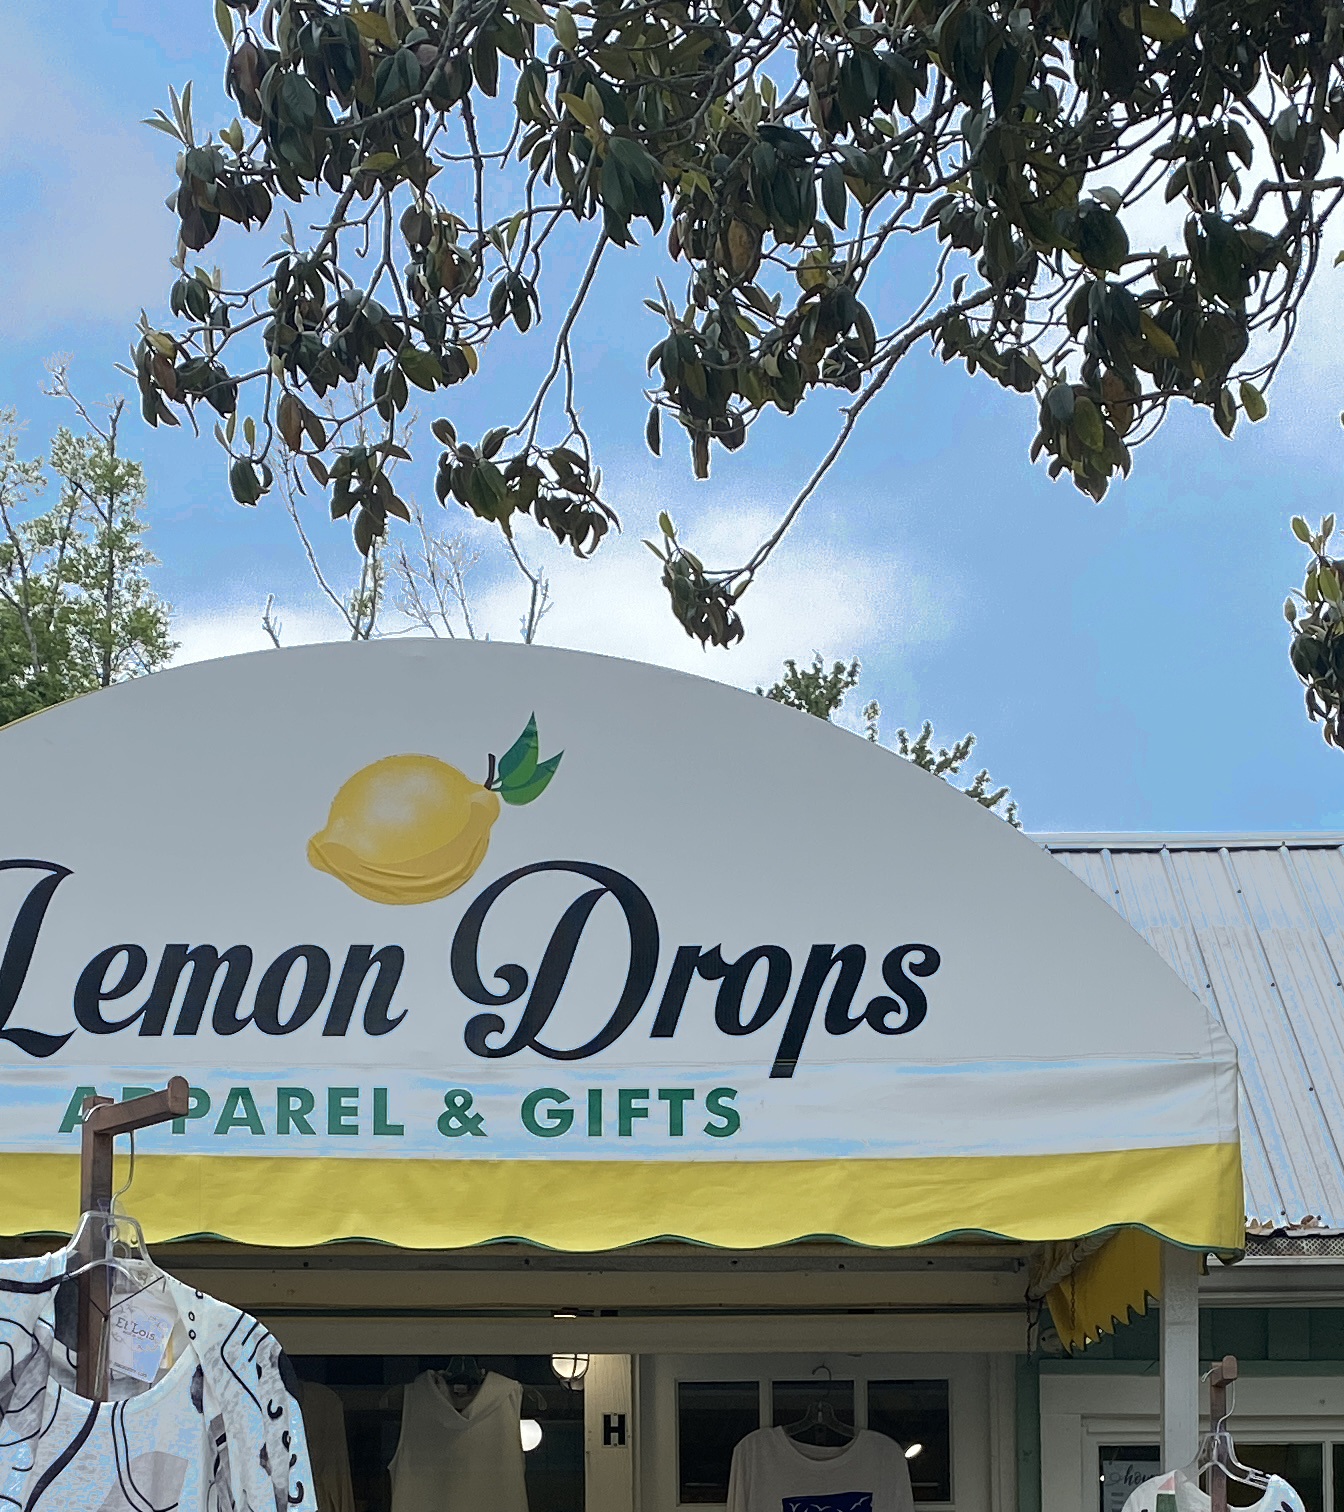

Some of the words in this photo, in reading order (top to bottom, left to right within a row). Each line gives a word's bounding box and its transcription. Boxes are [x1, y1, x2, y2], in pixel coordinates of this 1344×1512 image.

[450, 859, 942, 1079] Drops
[437, 1088, 487, 1138] &
[520, 1087, 741, 1138] GIFTS
[603, 1414, 626, 1446] H
